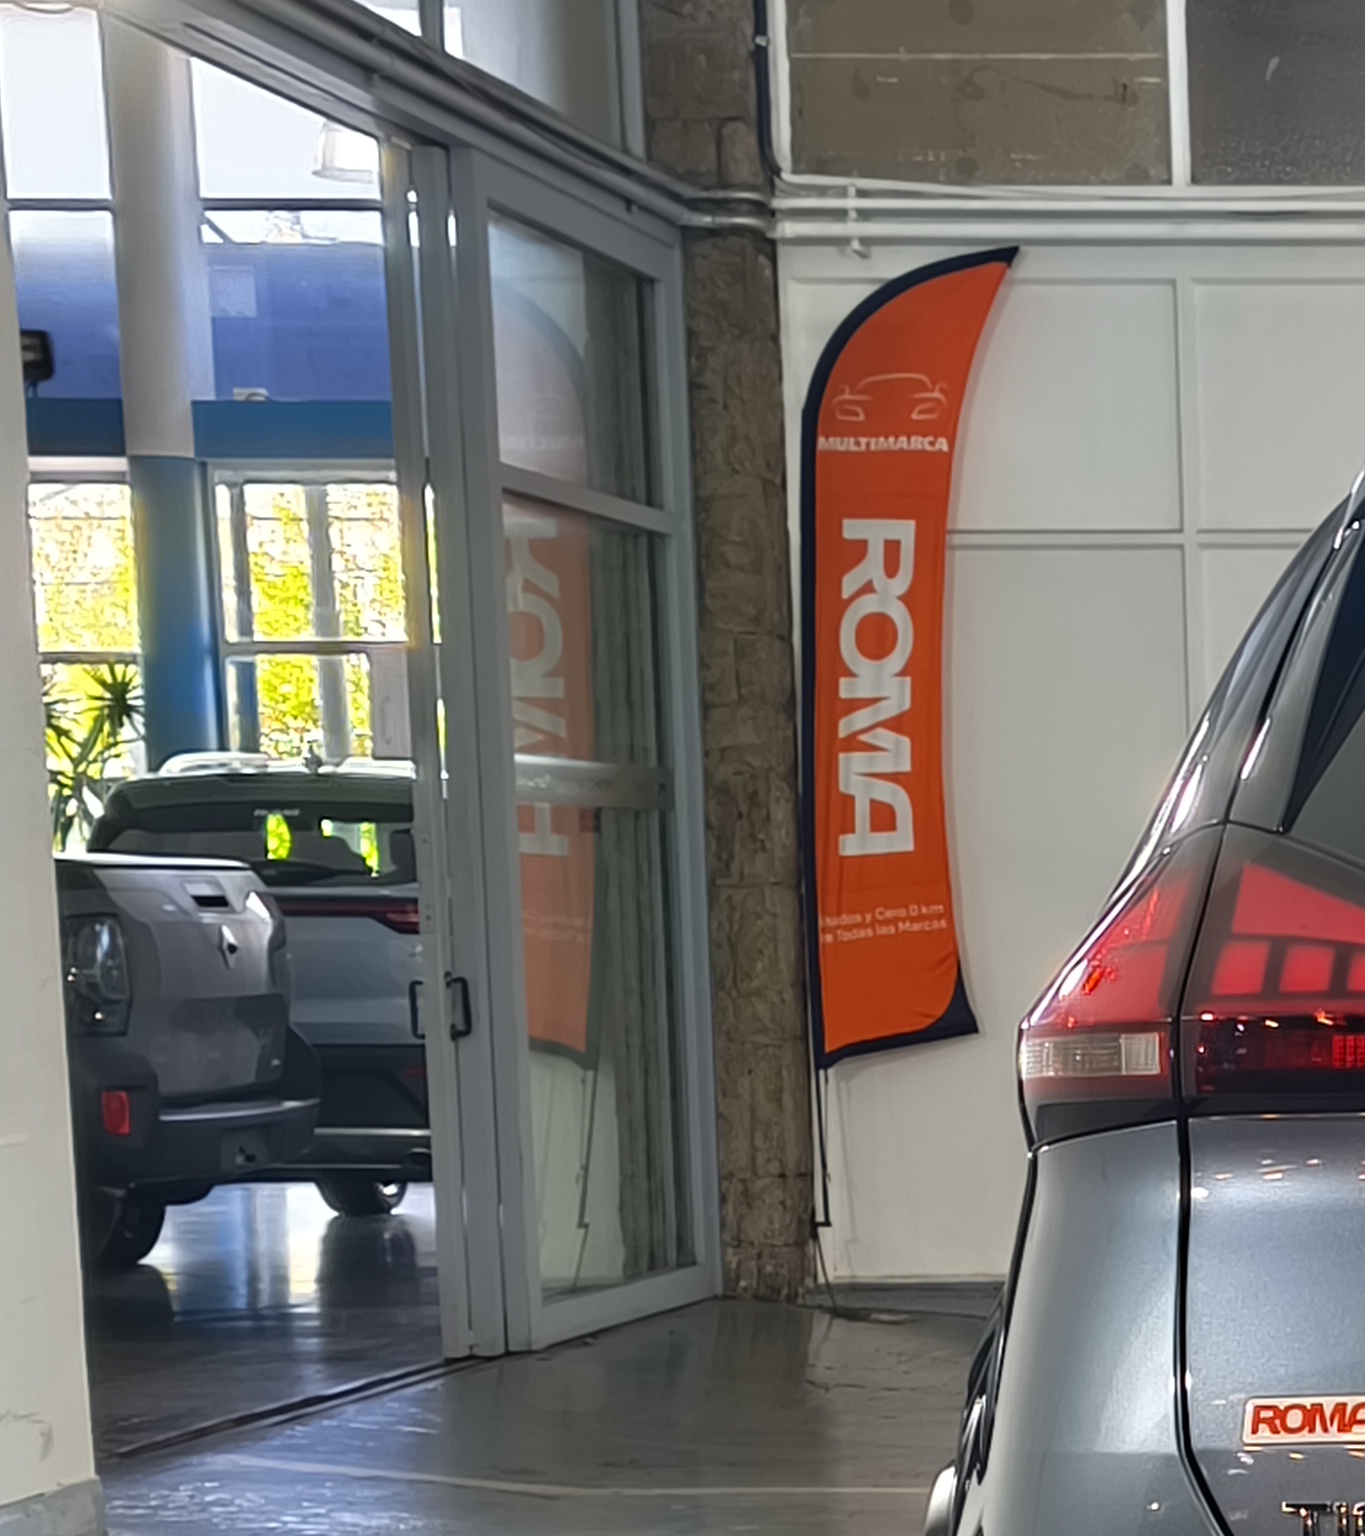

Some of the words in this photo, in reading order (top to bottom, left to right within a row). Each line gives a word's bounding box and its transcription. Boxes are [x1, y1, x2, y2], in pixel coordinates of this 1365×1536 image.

[818, 435, 949, 452] MULTIMARCA
[838, 518, 916, 857] ROMA
[921, 903, 944, 915] km
[837, 926, 873, 942] Todas
[876, 923, 895, 935] las
[898, 919, 947, 933] Marcas
